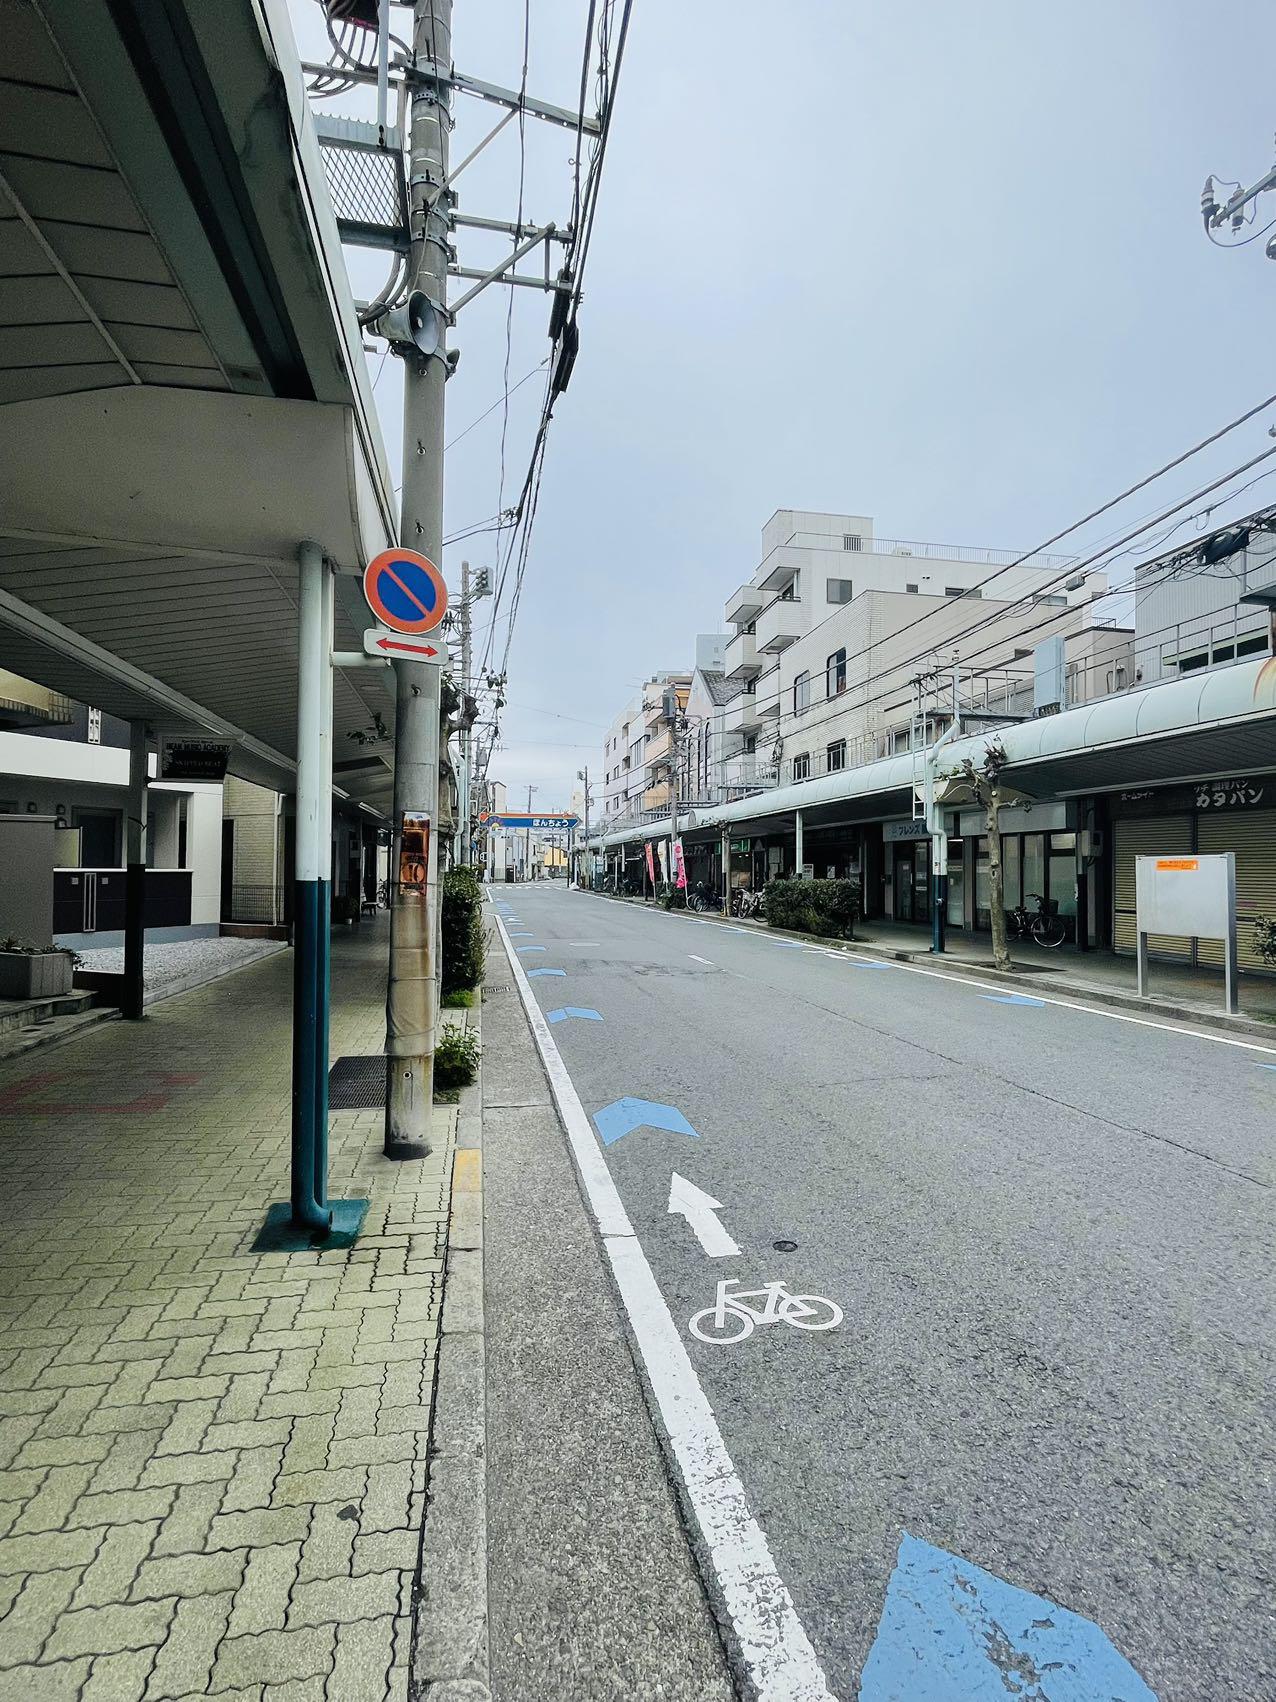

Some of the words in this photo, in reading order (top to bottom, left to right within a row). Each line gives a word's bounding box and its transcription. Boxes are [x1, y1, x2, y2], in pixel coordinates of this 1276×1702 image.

[532, 818, 569, 827] ほんちょう
